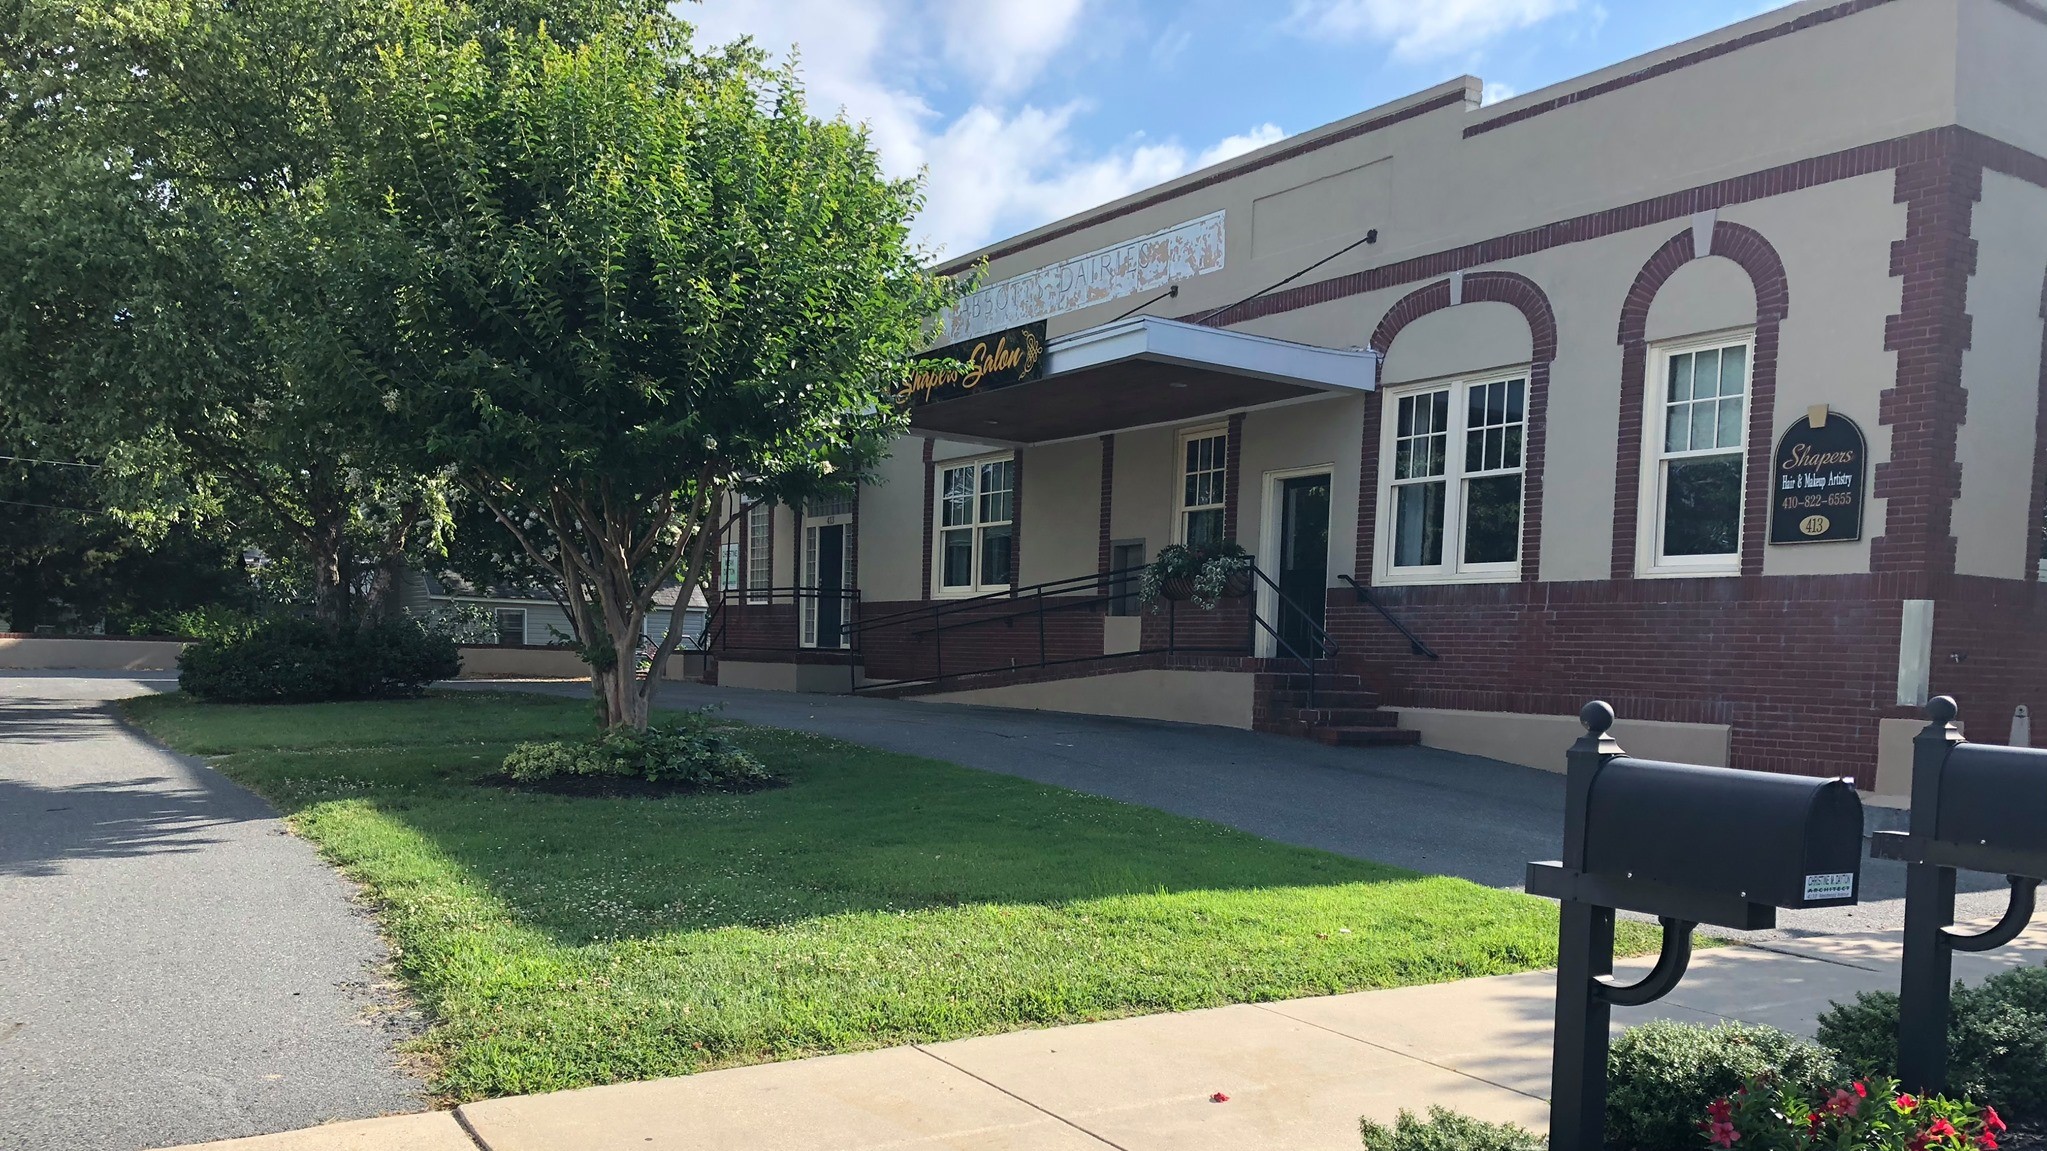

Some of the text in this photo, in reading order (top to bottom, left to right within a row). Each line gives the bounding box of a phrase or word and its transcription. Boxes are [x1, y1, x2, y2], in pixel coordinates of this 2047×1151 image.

[1060, 242, 1149, 293] DAIRIES
[962, 336, 1023, 389] Salon
[1782, 443, 1854, 472] Shapers
[1782, 470, 1853, 490] Hair & Makeup Artistry
[1782, 492, 1852, 509] 410-822-6555
[1805, 517, 1824, 533] 413
[1807, 885, 1850, 893] ARCHITECT
